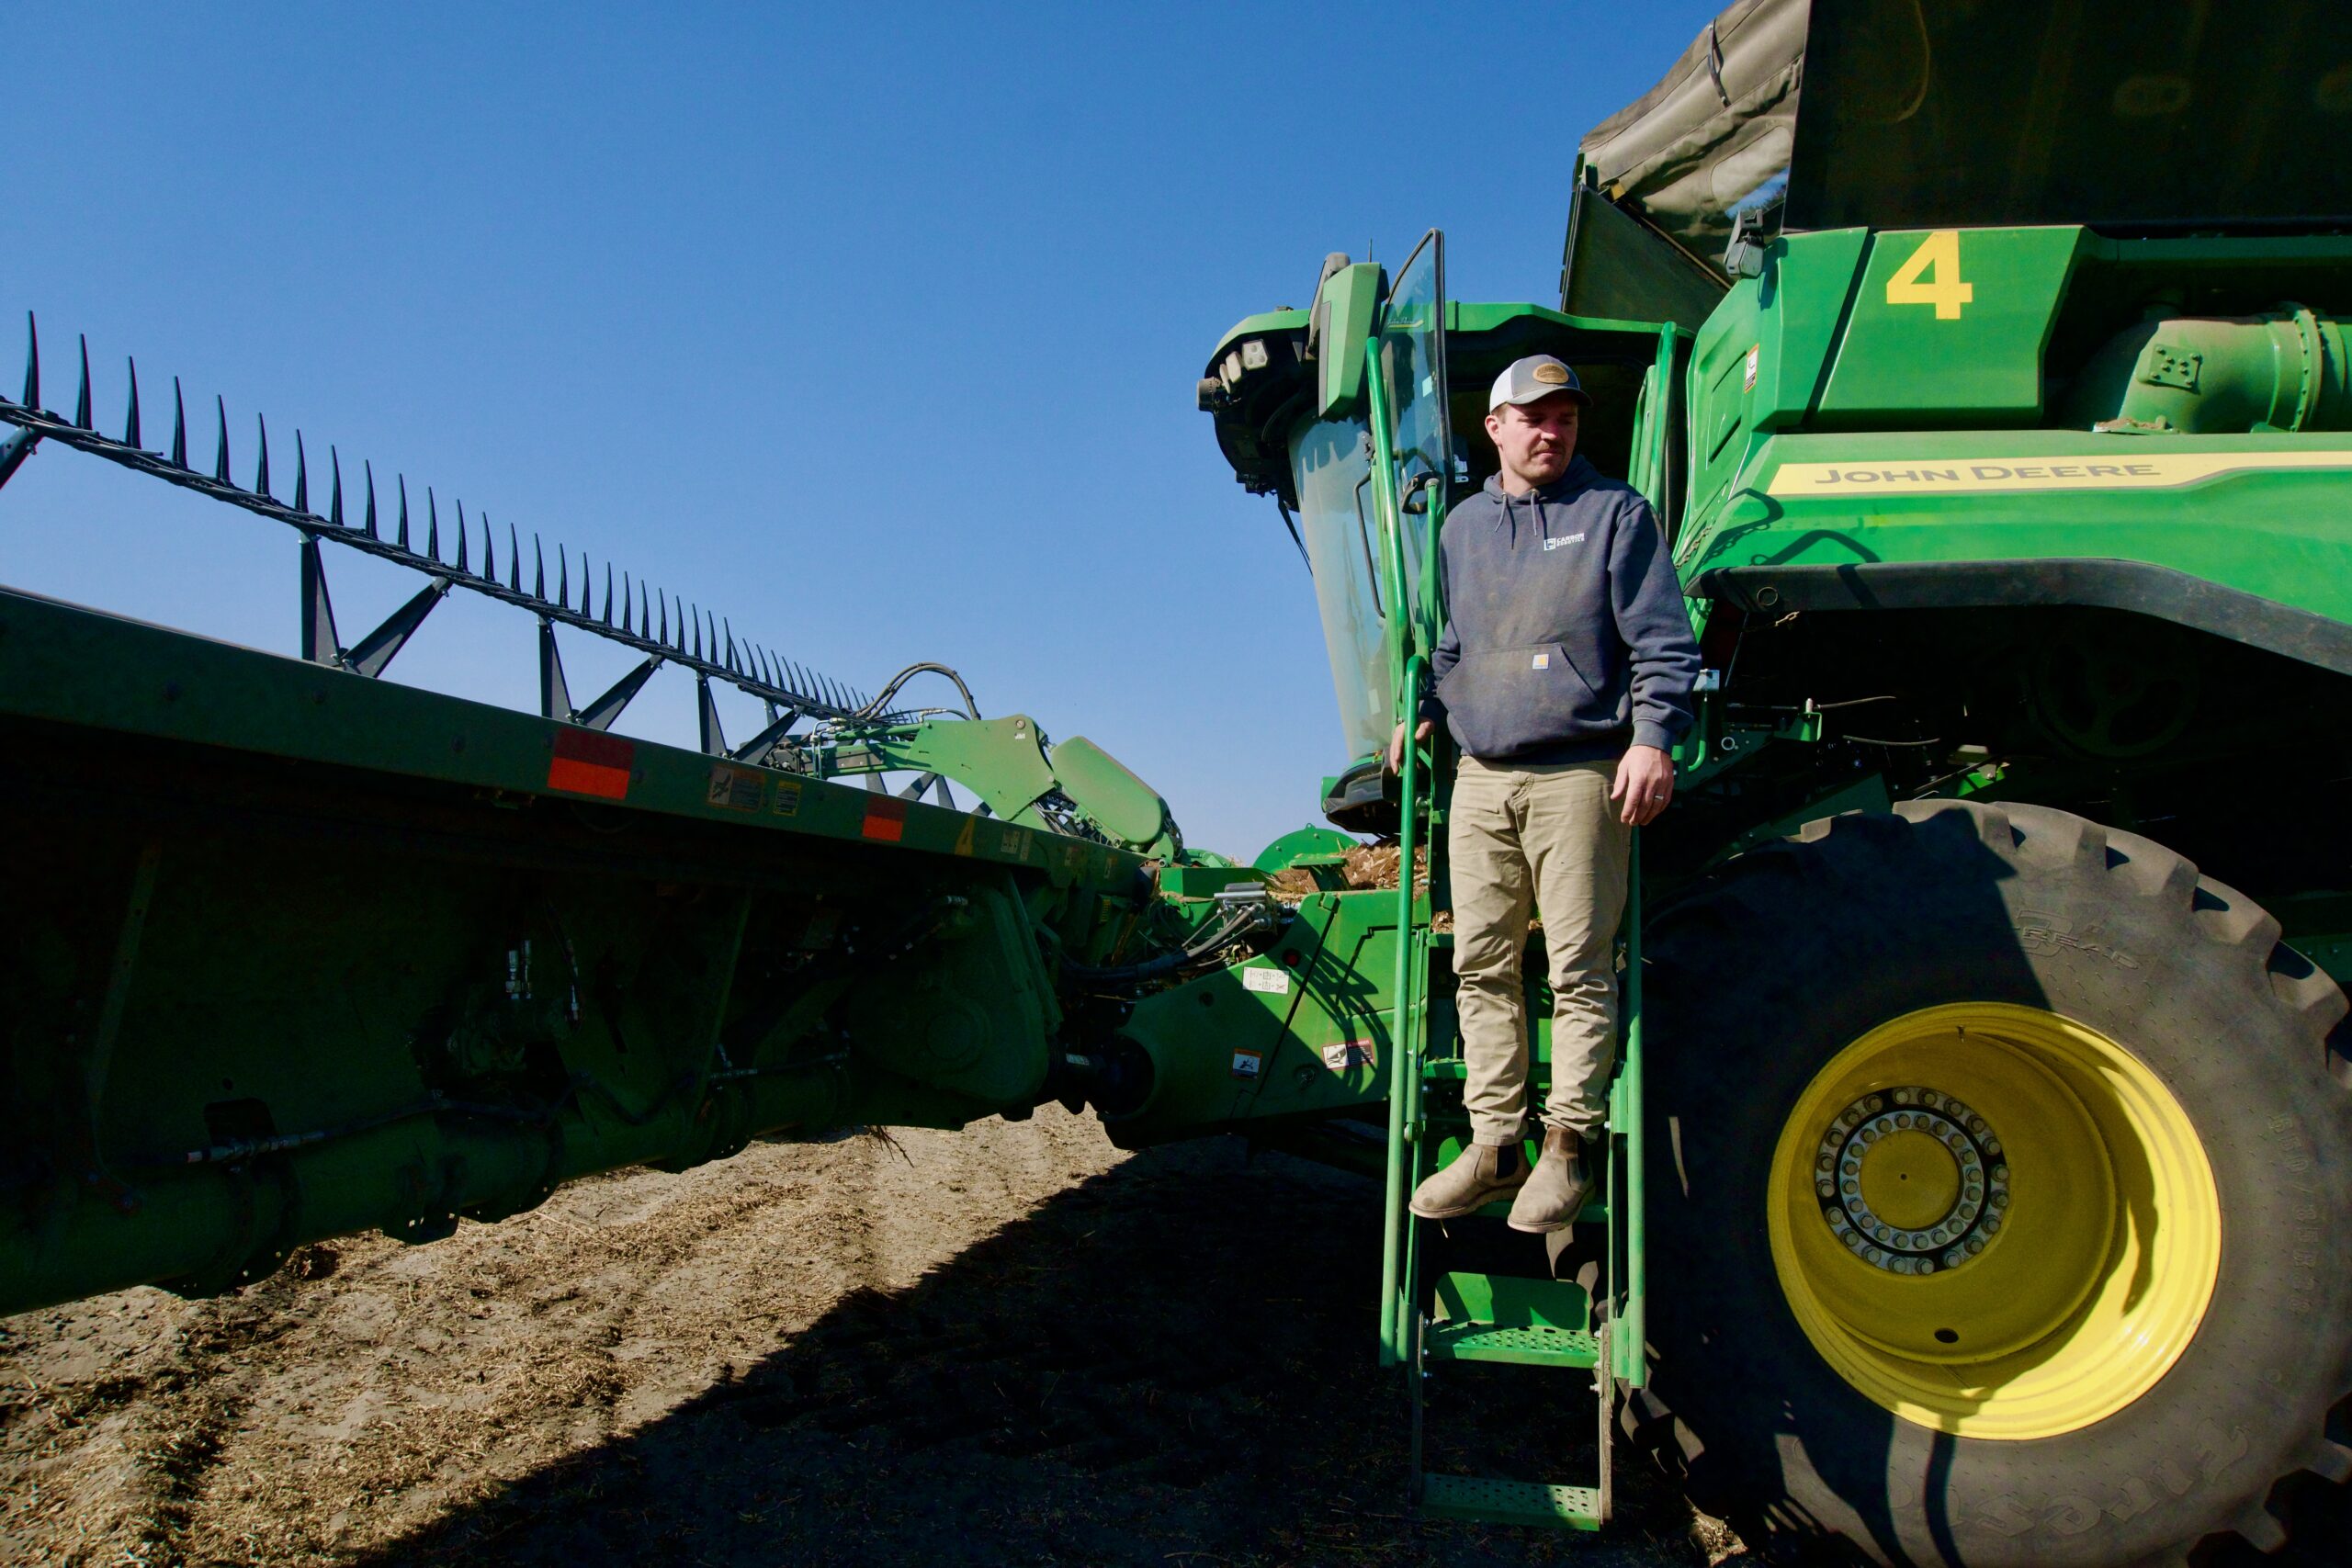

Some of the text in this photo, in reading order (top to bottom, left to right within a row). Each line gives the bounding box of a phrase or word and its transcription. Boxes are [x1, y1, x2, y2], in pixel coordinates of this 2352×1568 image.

[1886, 231, 1973, 319] 4
[1815, 464, 2161, 484] JOHN DEERE
